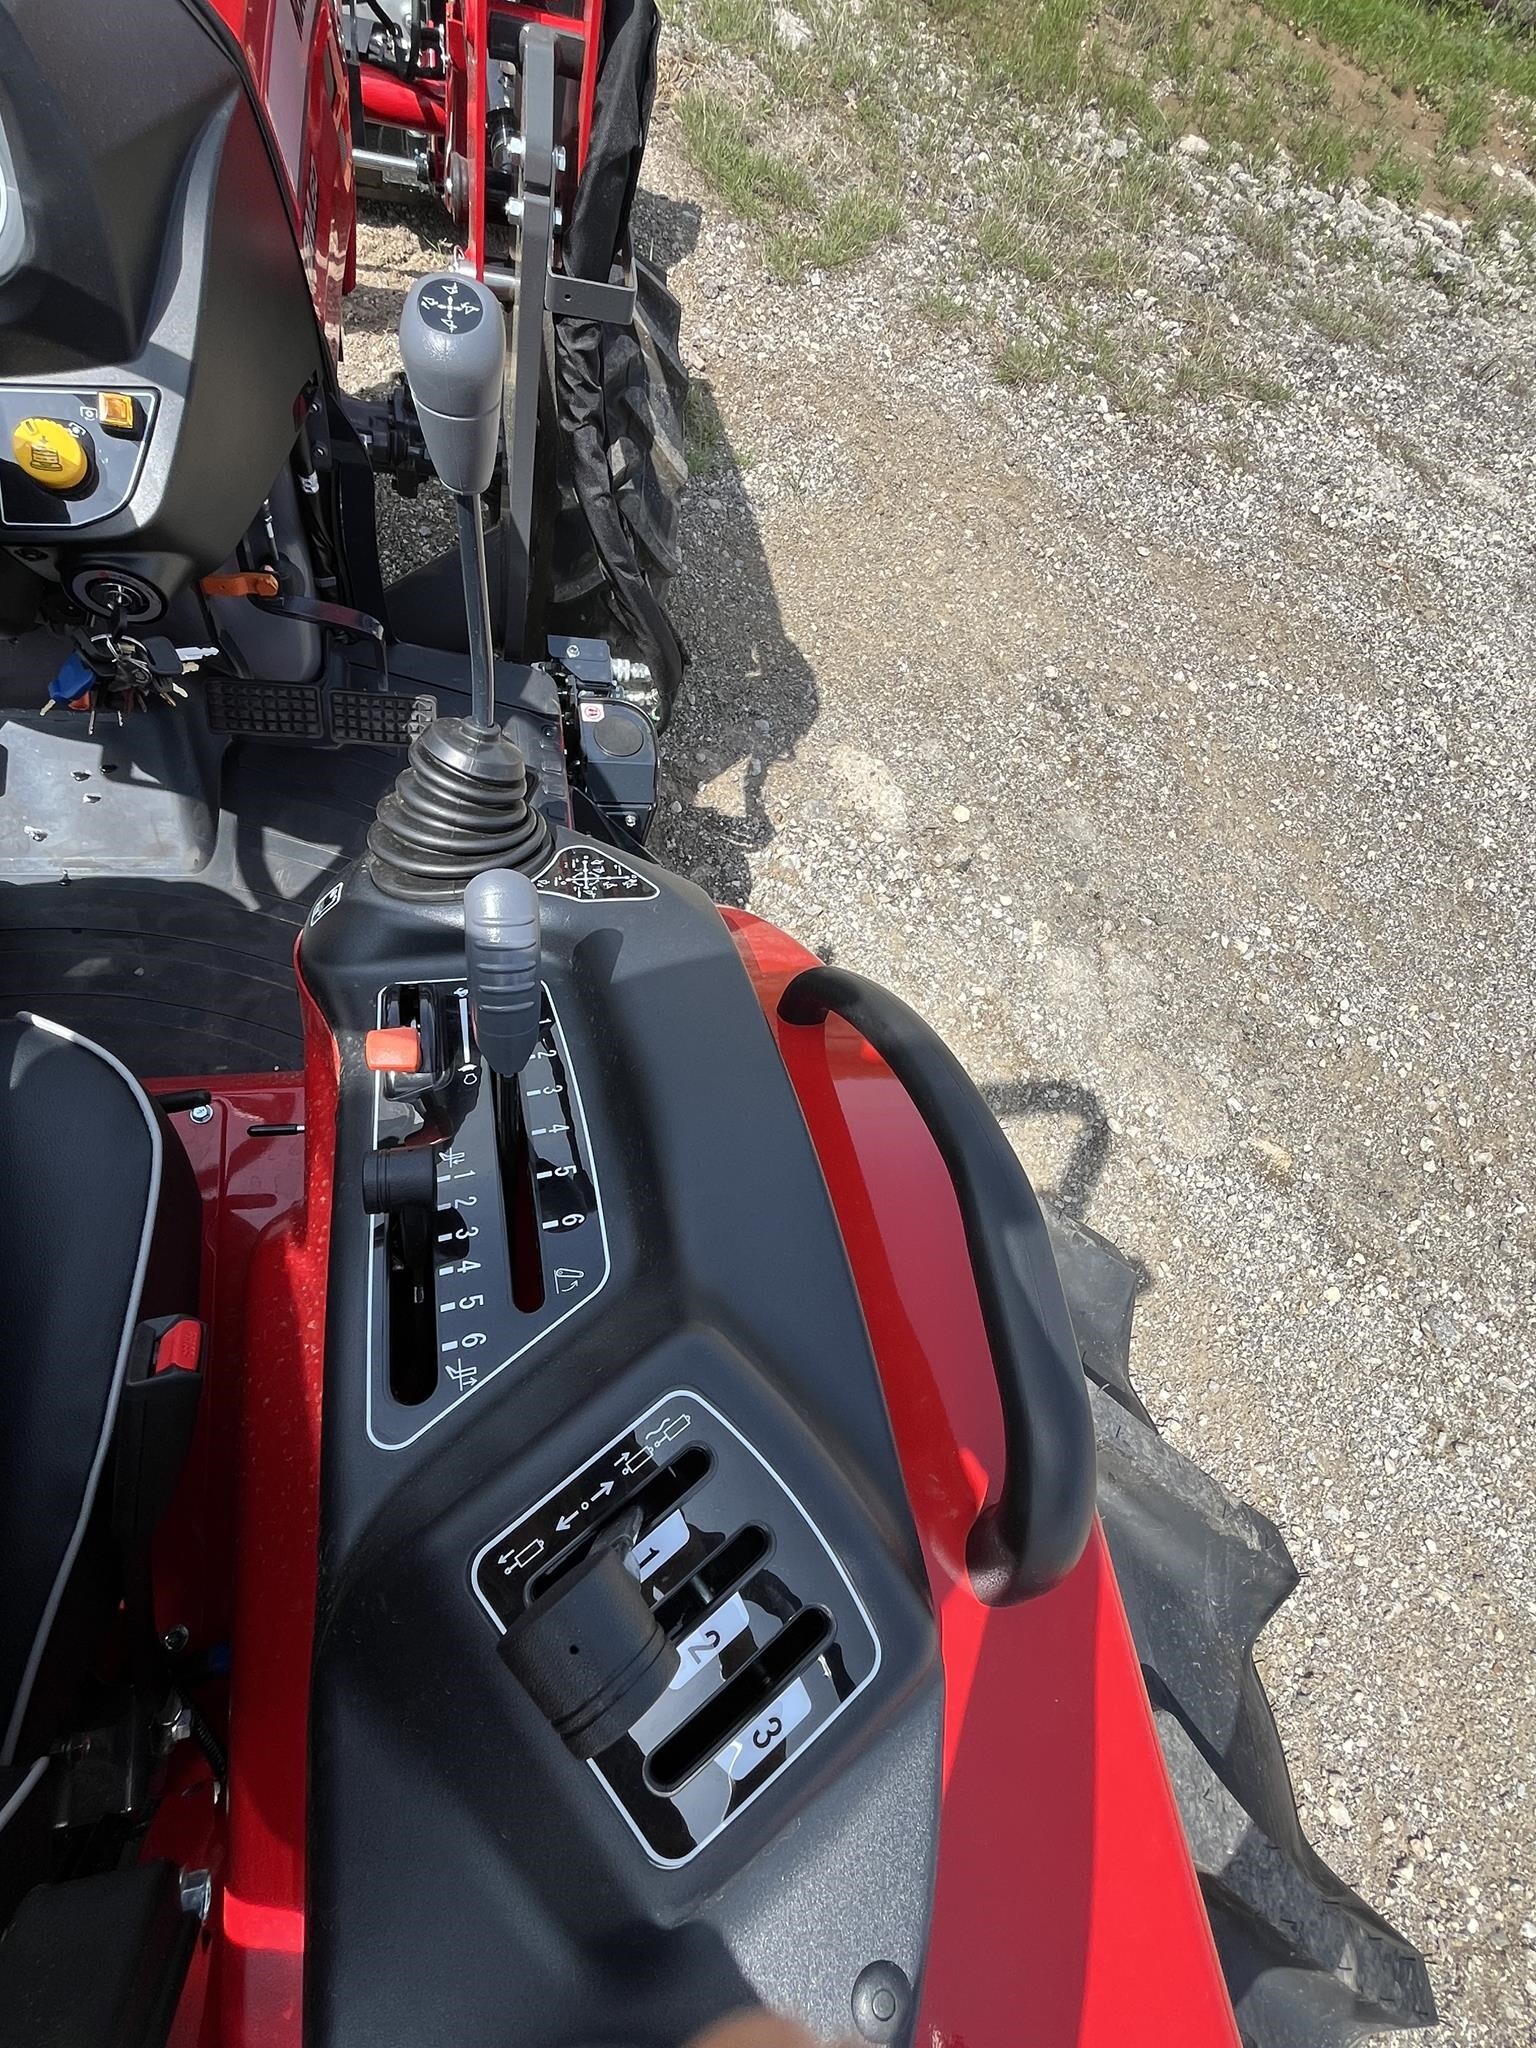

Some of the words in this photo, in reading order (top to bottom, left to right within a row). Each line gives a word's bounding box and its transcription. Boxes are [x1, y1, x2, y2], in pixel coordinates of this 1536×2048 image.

[537, 1050, 558, 1060] 2
[542, 1085, 564, 1095] 3
[548, 1124, 570, 1134] 4
[453, 1169, 477, 1179] 1
[554, 1165, 578, 1177] 5
[454, 1196, 478, 1210] 2
[561, 1213, 586, 1227] 6
[455, 1226, 480, 1240] 3
[457, 1260, 482, 1274] 4
[459, 1294, 485, 1310] 5
[461, 1332, 488, 1348] 6
[638, 1547, 661, 1570] 1
[687, 1630, 721, 1665] 2
[752, 1717, 783, 1749] 3
